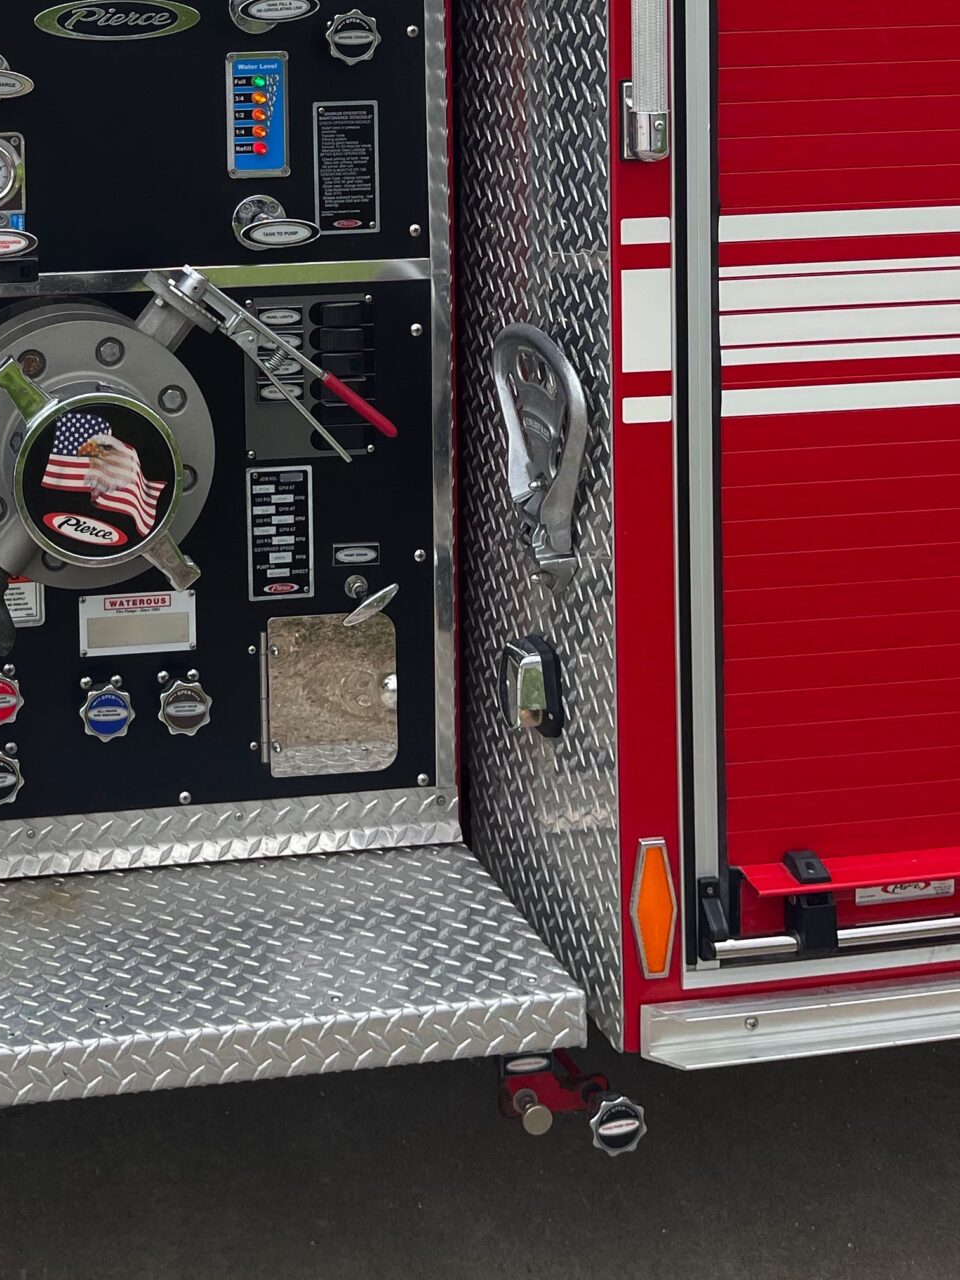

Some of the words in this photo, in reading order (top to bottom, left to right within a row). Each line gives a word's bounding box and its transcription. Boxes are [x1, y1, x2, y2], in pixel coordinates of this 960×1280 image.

[64, 7, 172, 30] Pierce
[58, 516, 113, 541] Pierce
[109, 597, 167, 608] WATEROUS
